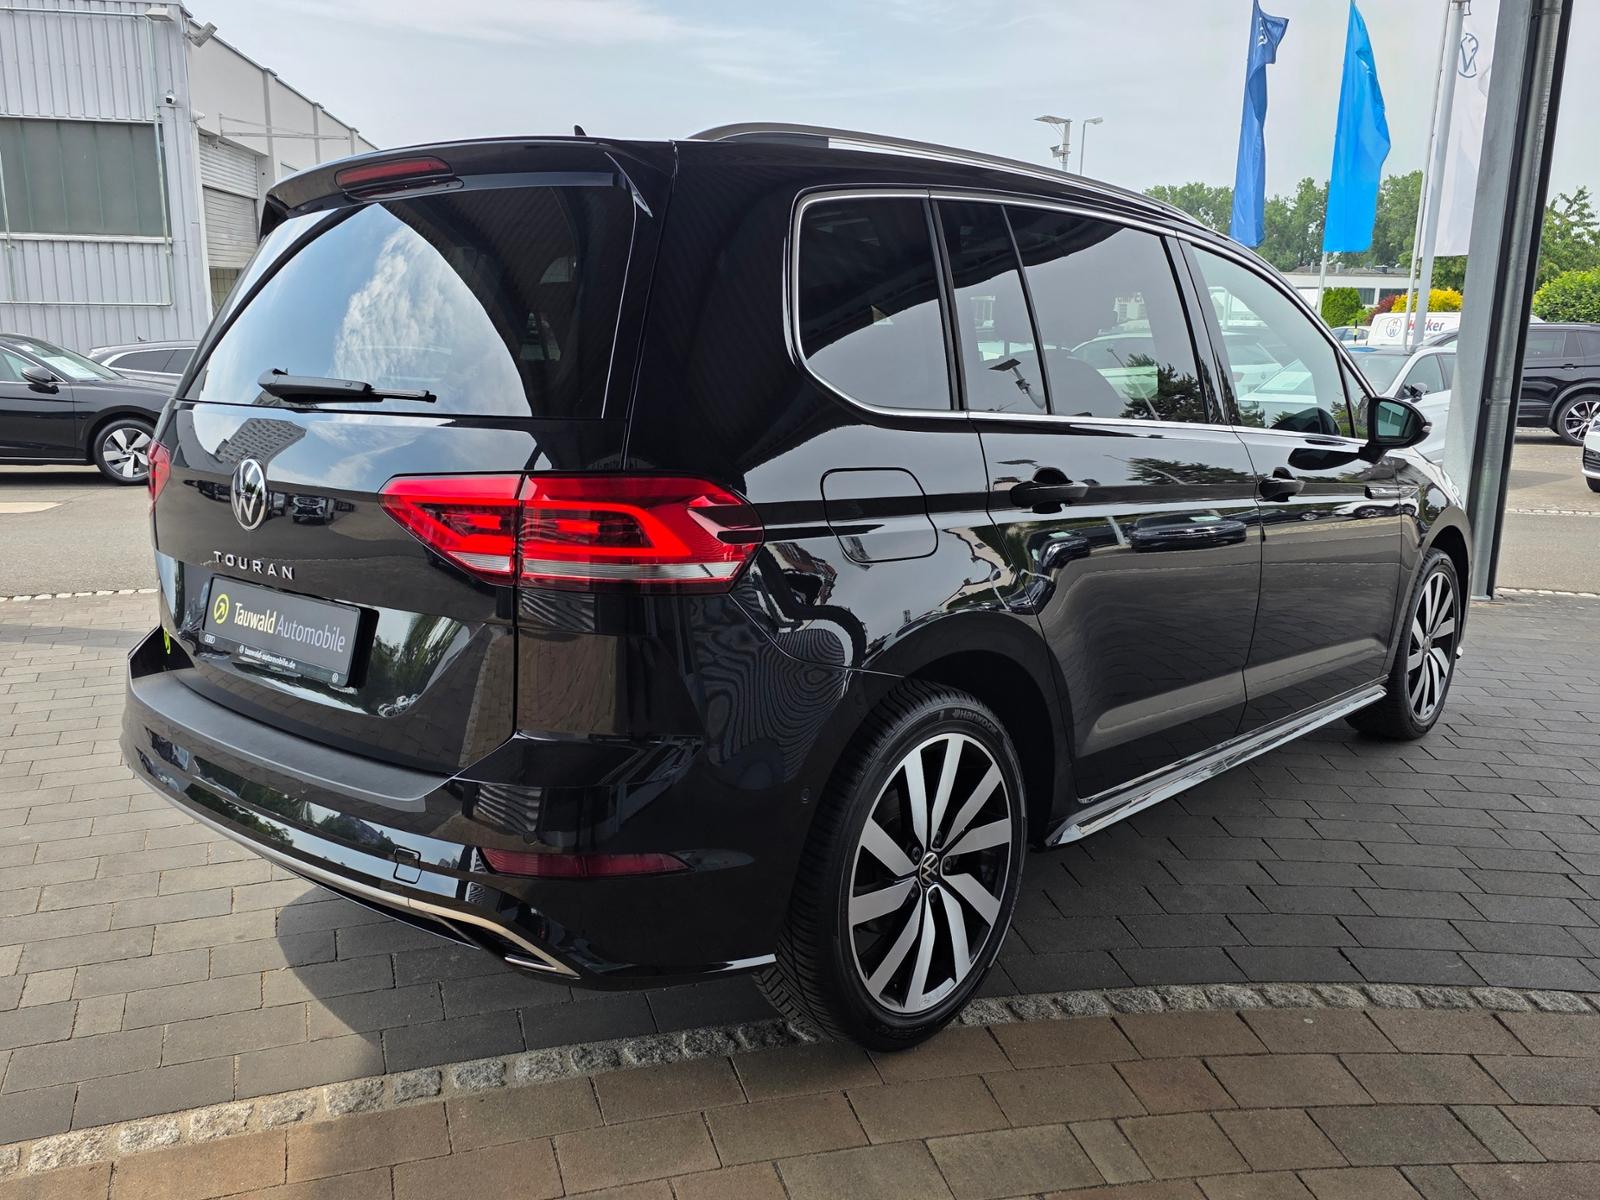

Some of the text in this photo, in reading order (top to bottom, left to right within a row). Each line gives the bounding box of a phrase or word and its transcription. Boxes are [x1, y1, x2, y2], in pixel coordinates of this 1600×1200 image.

[1407, 319, 1445, 332] Hker
[213, 550, 295, 580] TOURAN
[234, 602, 346, 653] Tauwald Automobile
